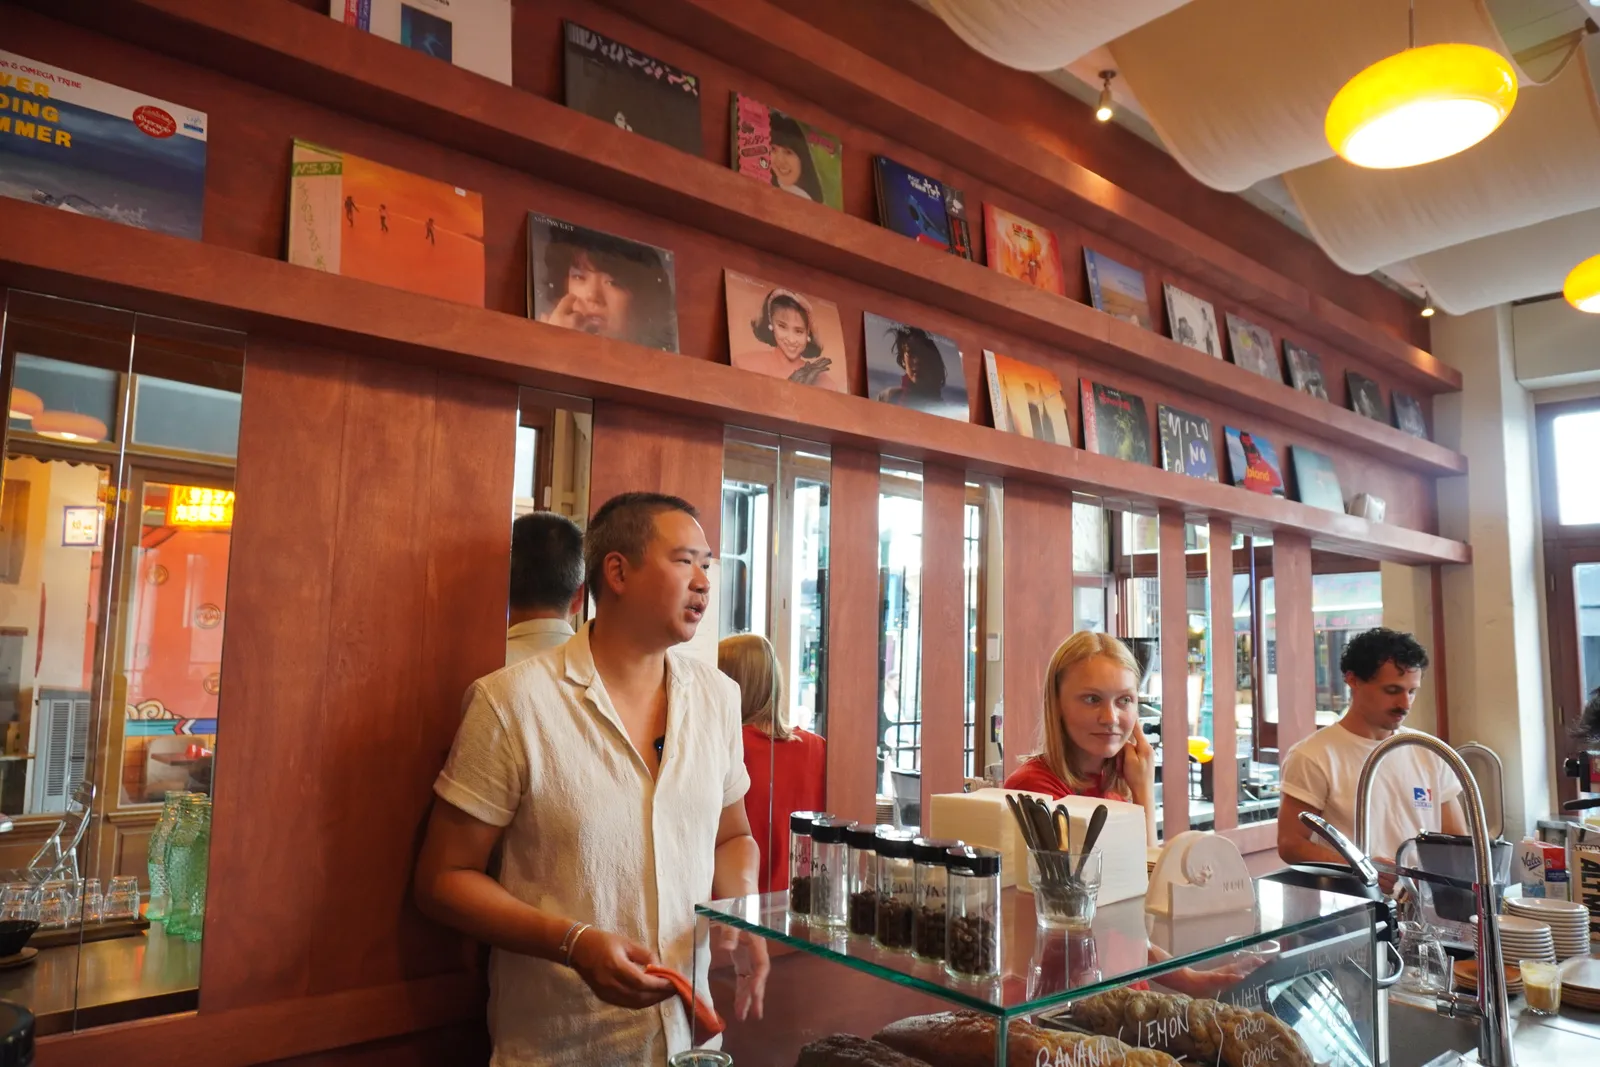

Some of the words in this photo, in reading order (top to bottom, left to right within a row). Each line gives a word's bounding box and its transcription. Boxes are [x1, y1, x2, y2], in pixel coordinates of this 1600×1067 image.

[20, 64, 55, 83] OMEGA
[57, 77, 82, 89] TRIBE
[1189, 443, 1207, 466] NO
[1247, 465, 1271, 482] blond
[1232, 979, 1274, 1012] WHITE
[1036, 1036, 1112, 1067] BANANA
